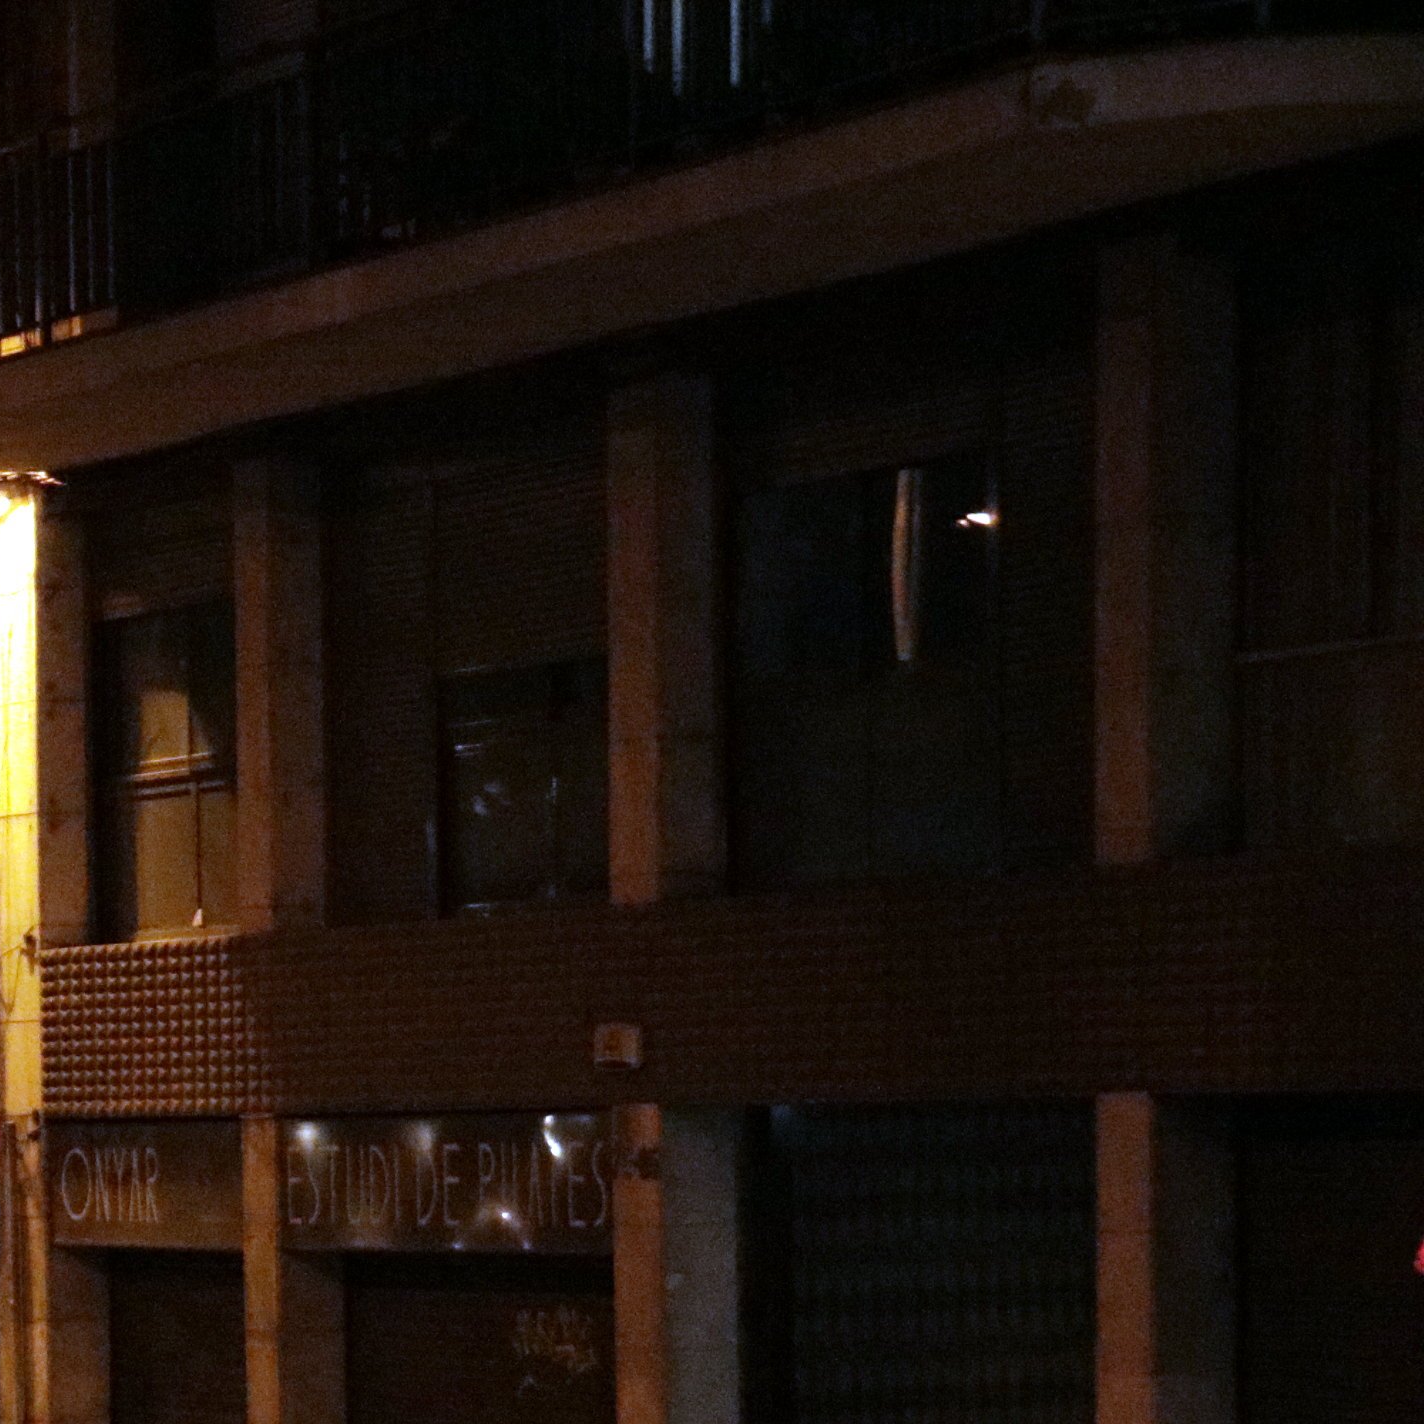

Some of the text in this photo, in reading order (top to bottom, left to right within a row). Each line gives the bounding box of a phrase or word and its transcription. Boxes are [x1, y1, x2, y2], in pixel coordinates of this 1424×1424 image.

[60, 1146, 161, 1224] ONYAR
[286, 1140, 608, 1228] ESTUDI DE PILATES
